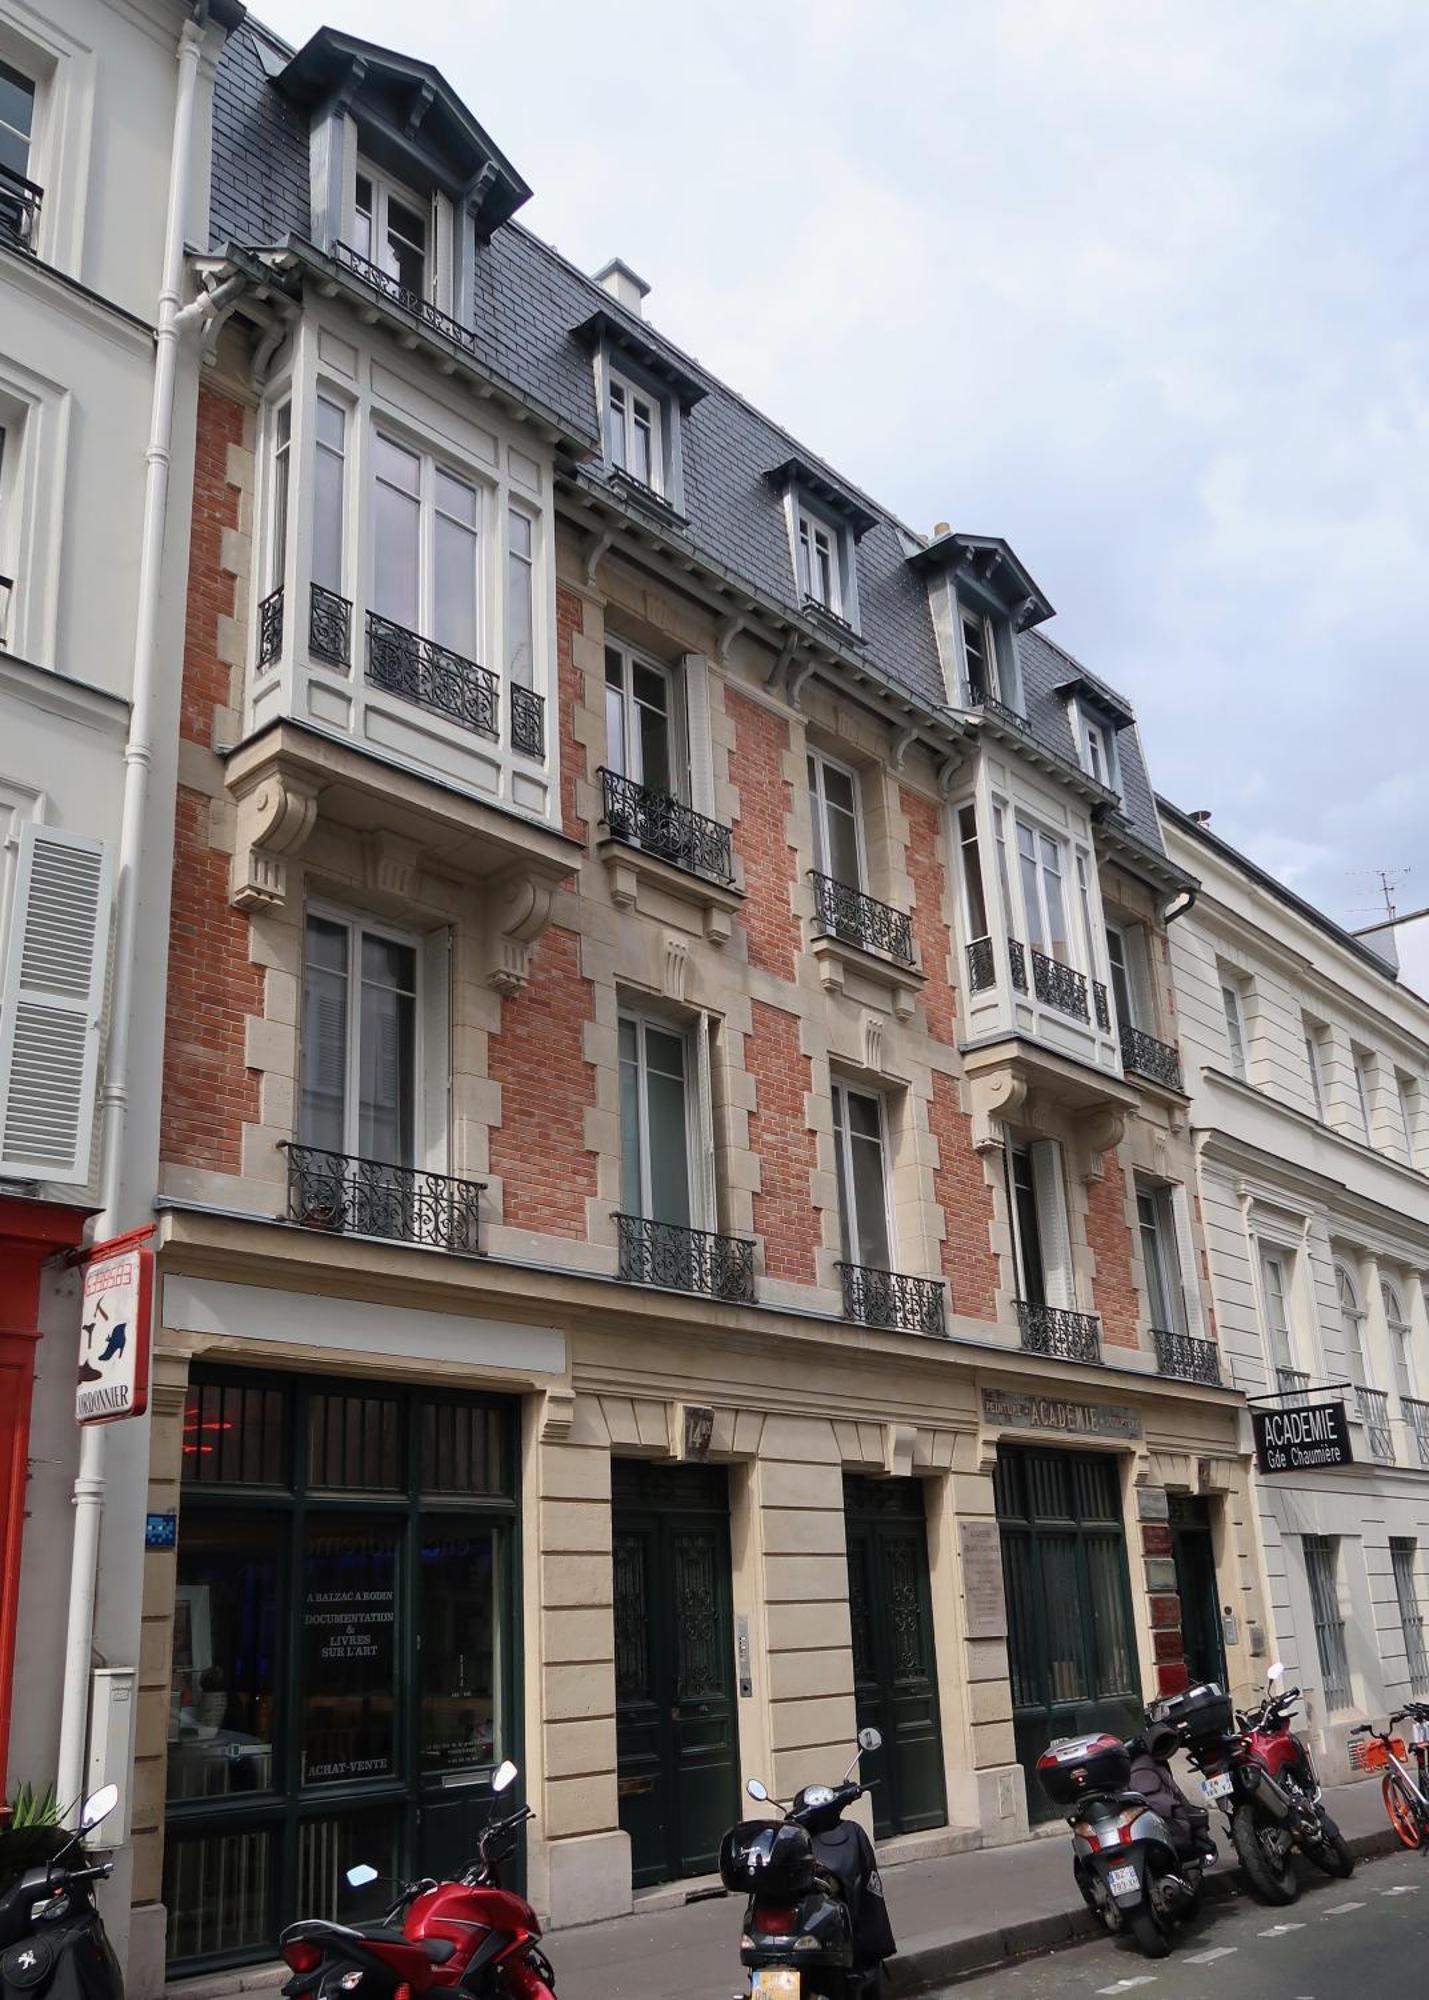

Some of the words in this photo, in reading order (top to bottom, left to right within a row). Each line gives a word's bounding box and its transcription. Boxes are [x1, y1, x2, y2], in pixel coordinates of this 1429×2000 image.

[79, 1384, 129, 1414] ORDONNIER
[1264, 1408, 1338, 1448] ACADEMIE
[1267, 1449, 1287, 1469] Gde
[1291, 1443, 1342, 1466] Chaumière
[316, 1591, 353, 1602] BALZAC
[304, 1612, 394, 1625] DOCUMENTATION
[346, 1624, 355, 1634] &
[329, 1634, 371, 1647] LIVRES
[321, 1646, 344, 1658] SUR
[347, 1645, 378, 1657] L'ART
[308, 1757, 388, 1777] ACHAT-VENTE
